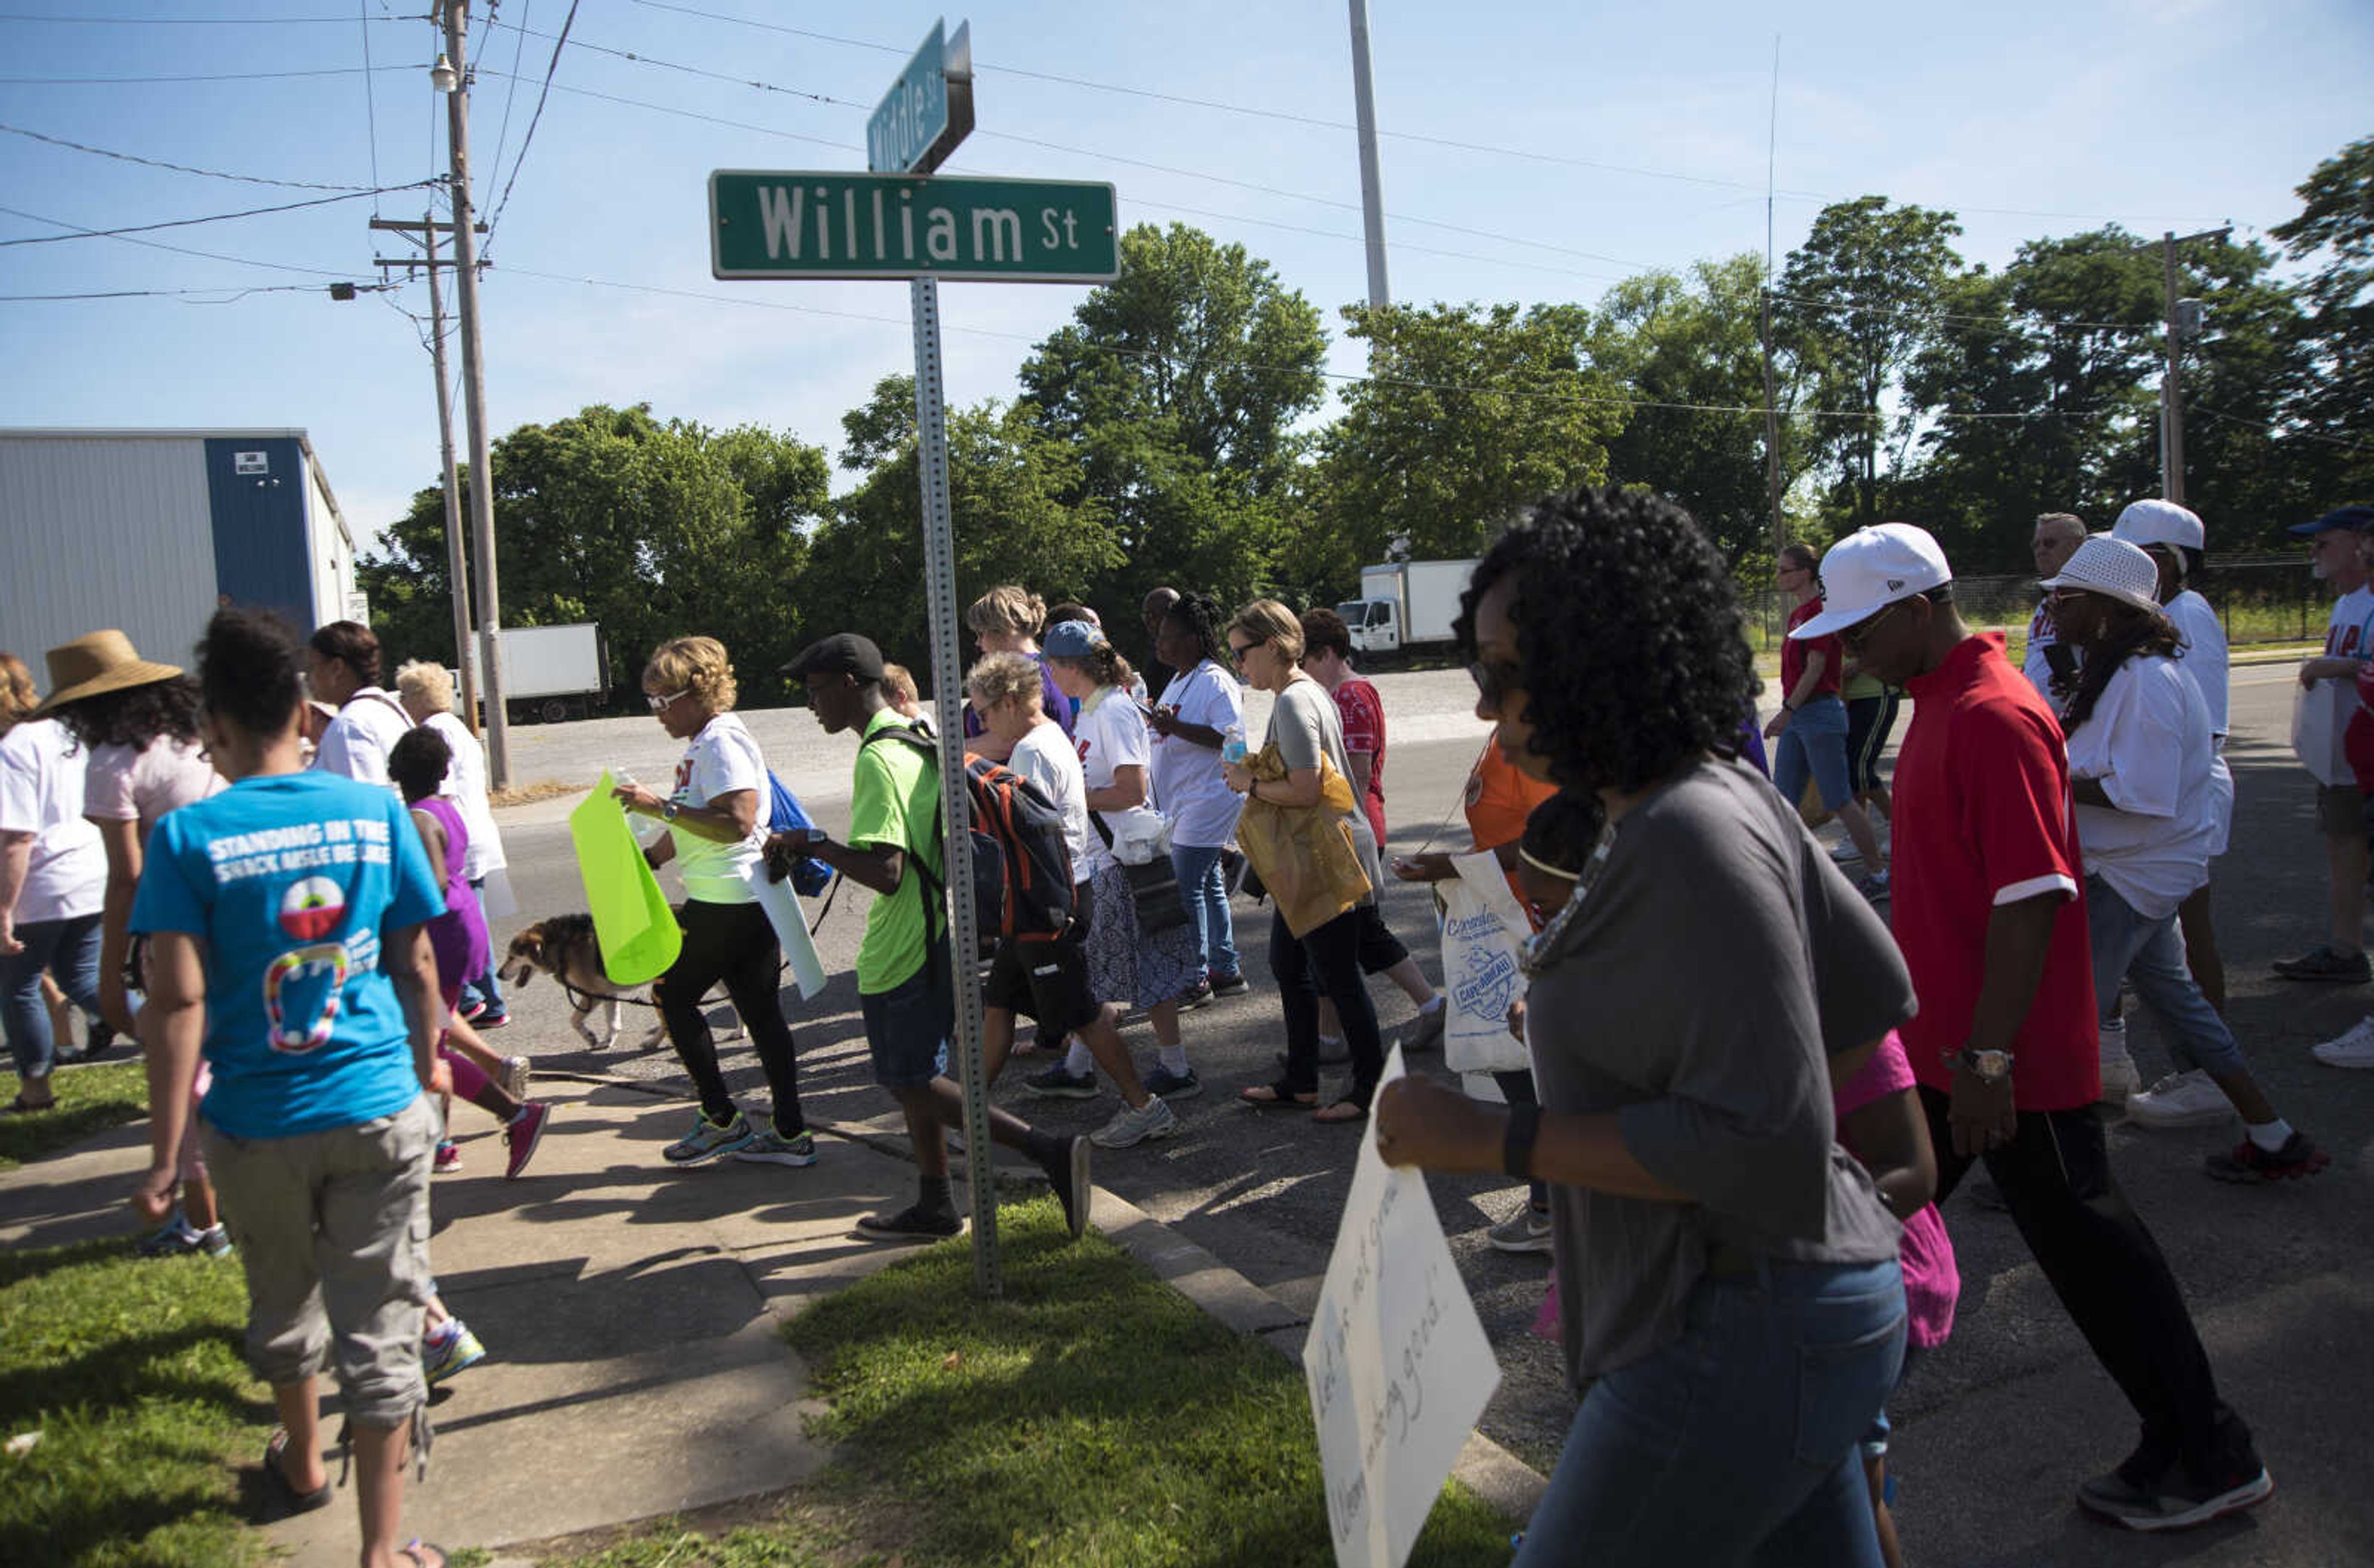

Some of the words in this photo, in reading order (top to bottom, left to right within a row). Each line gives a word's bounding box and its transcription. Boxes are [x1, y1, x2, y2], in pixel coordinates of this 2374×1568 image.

[758, 186, 1023, 262] William
[1041, 208, 1079, 250] St
[208, 823, 323, 862] STANDING
